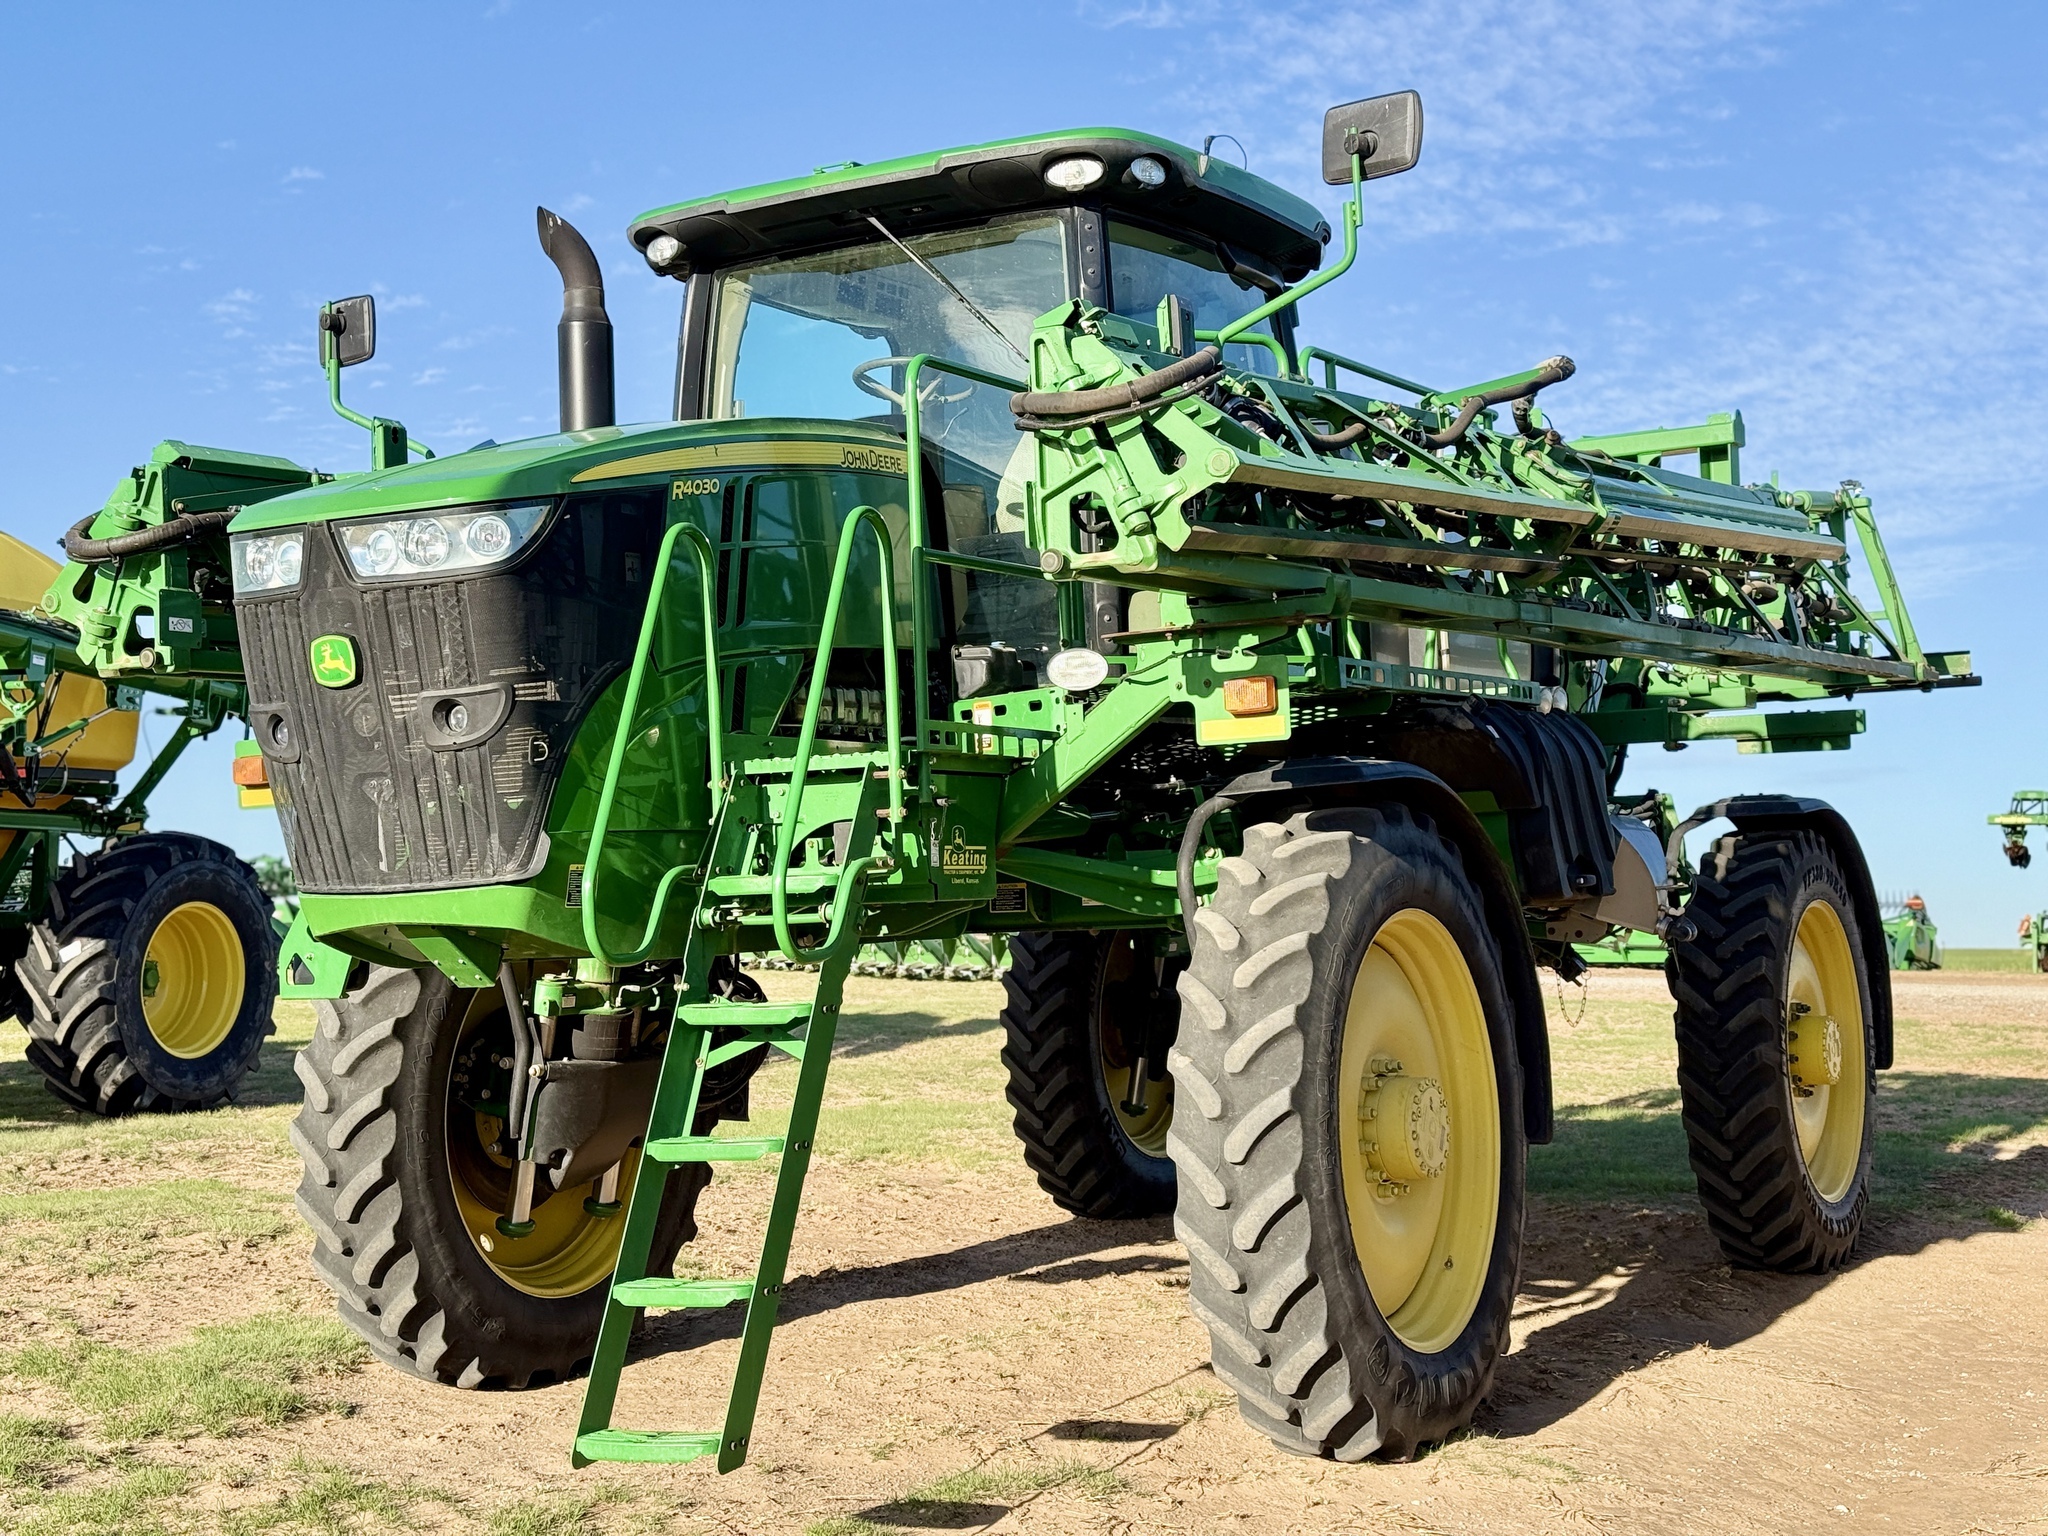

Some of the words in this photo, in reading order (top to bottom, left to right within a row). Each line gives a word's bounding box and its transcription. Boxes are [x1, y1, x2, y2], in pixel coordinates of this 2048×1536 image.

[840, 447, 870, 469] JOHN
[869, 449, 903, 473] DEERE
[671, 477, 720, 500] R4030
[943, 849, 987, 875] Keating
